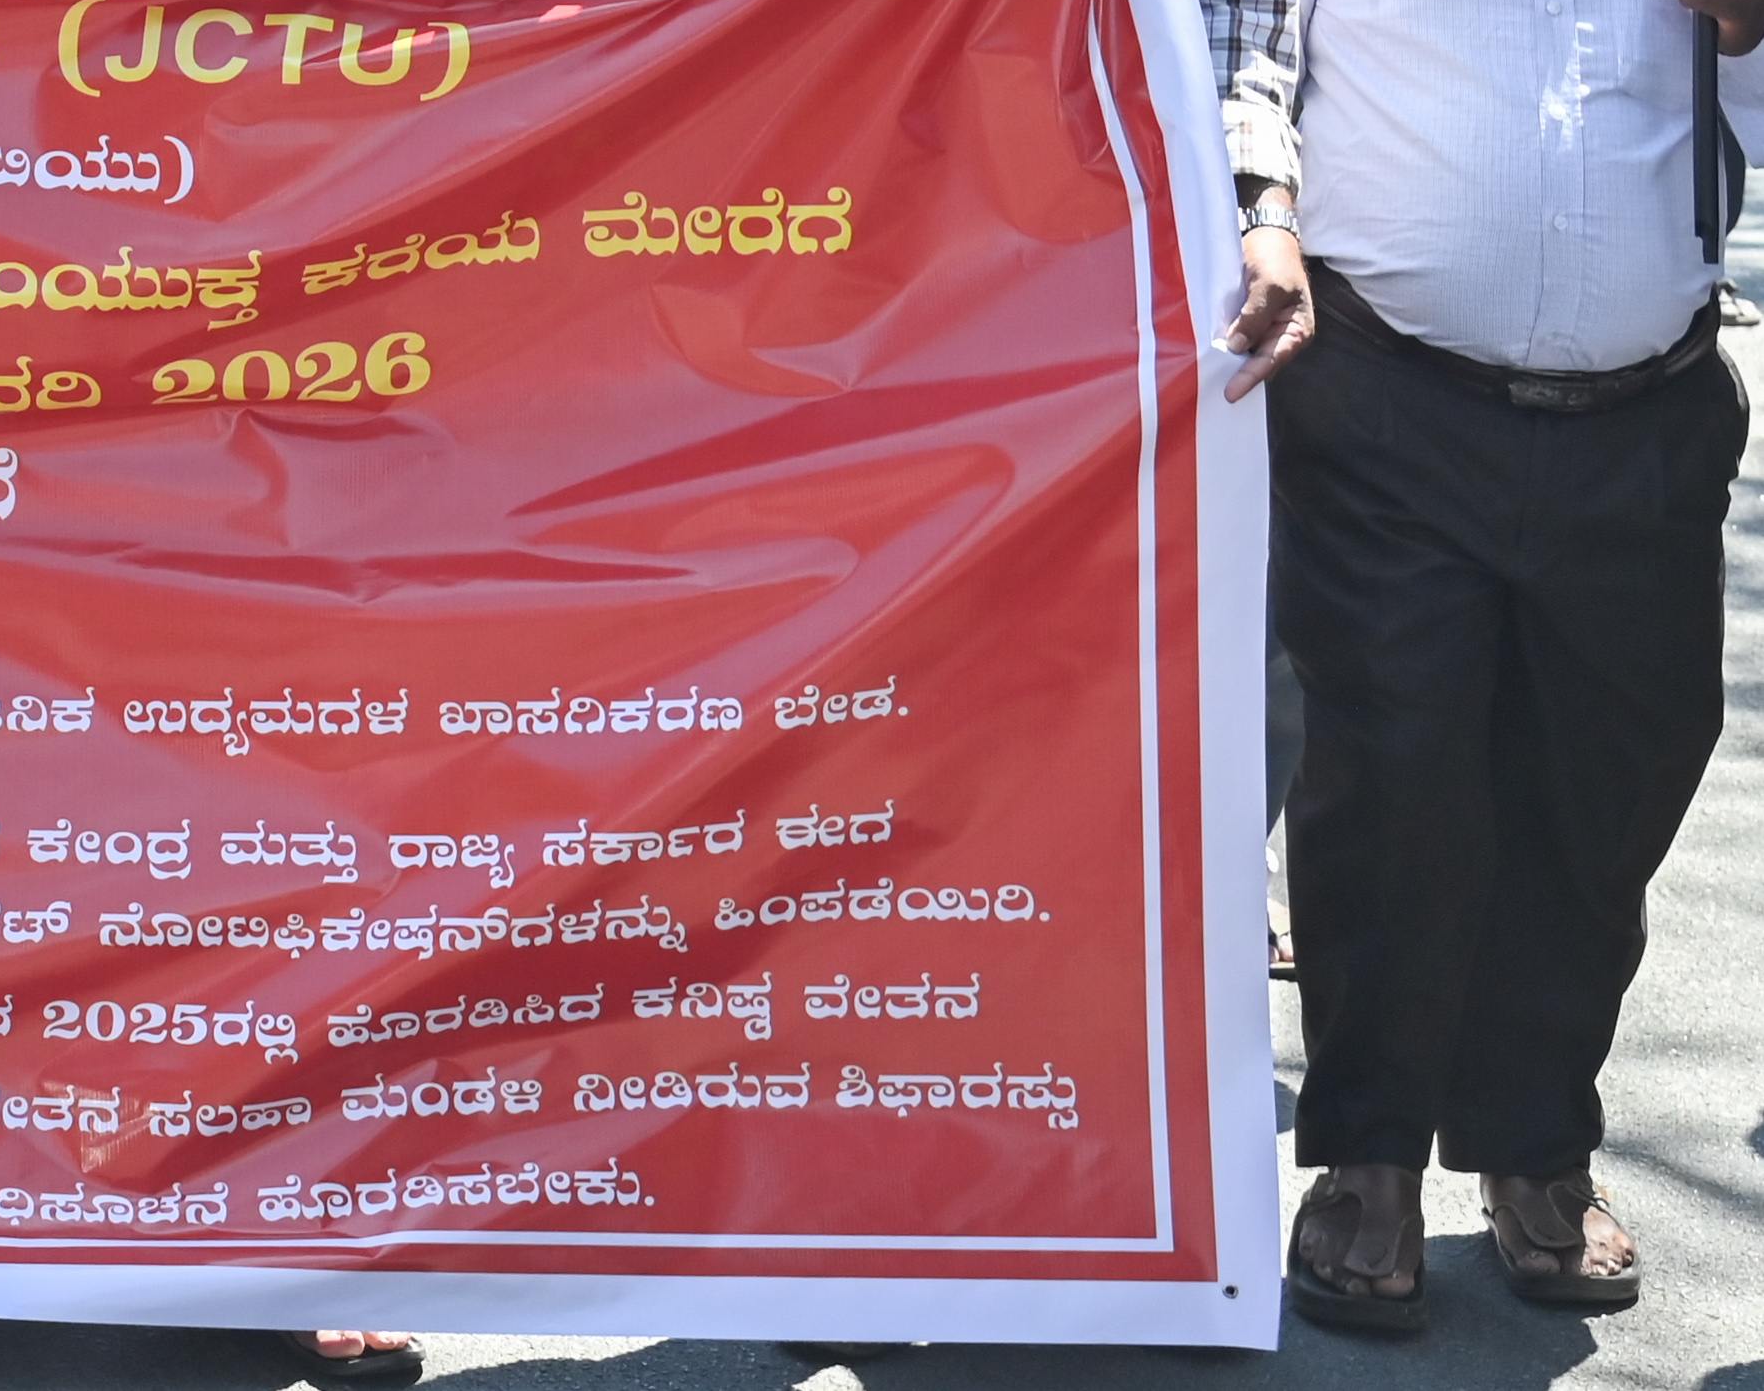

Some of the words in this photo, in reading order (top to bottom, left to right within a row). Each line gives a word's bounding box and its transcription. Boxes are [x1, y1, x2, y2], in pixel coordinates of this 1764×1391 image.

[299, 210, 540, 296] ಕರೆಯ
[580, 187, 853, 257] ಮೇರೆಗೆ
[151, 331, 433, 407] 2026
[123, 686, 410, 757] ಉದ್ಯಮಗಳ
[439, 684, 743, 735] ಖಾಸಗಿಕರಣ
[774, 675, 910, 731] ಬೇಡ.
[26, 818, 192, 884] ಕೇಂದ್ರ
[220, 818, 360, 885] ಮತ್ತು
[388, 833, 517, 888] ರಾಜ್ಯ
[541, 807, 746, 869] ಸರ್ಕಾರ
[775, 799, 894, 851] ಈಗ
[714, 876, 1051, 935] ಹಿಂಪಡೆಯಿರಿ.
[42, 998, 298, 1064] 2025ರಲ್ಲಿ
[326, 981, 606, 1049] ಹೊರಡಿಸಿದ
[803, 972, 981, 1021] ವೇತನ
[149, 1090, 312, 1138] ಸಲಹಾ
[341, 1065, 542, 1123] ಮಂಡಳಿ
[572, 1064, 811, 1115] ನೀಡಿರುವ
[835, 1062, 1080, 1131] ಶಿಫಾರಸ್ಸು
[258, 1156, 655, 1221] ಹೊರಡಿಸಬೇಕು.
